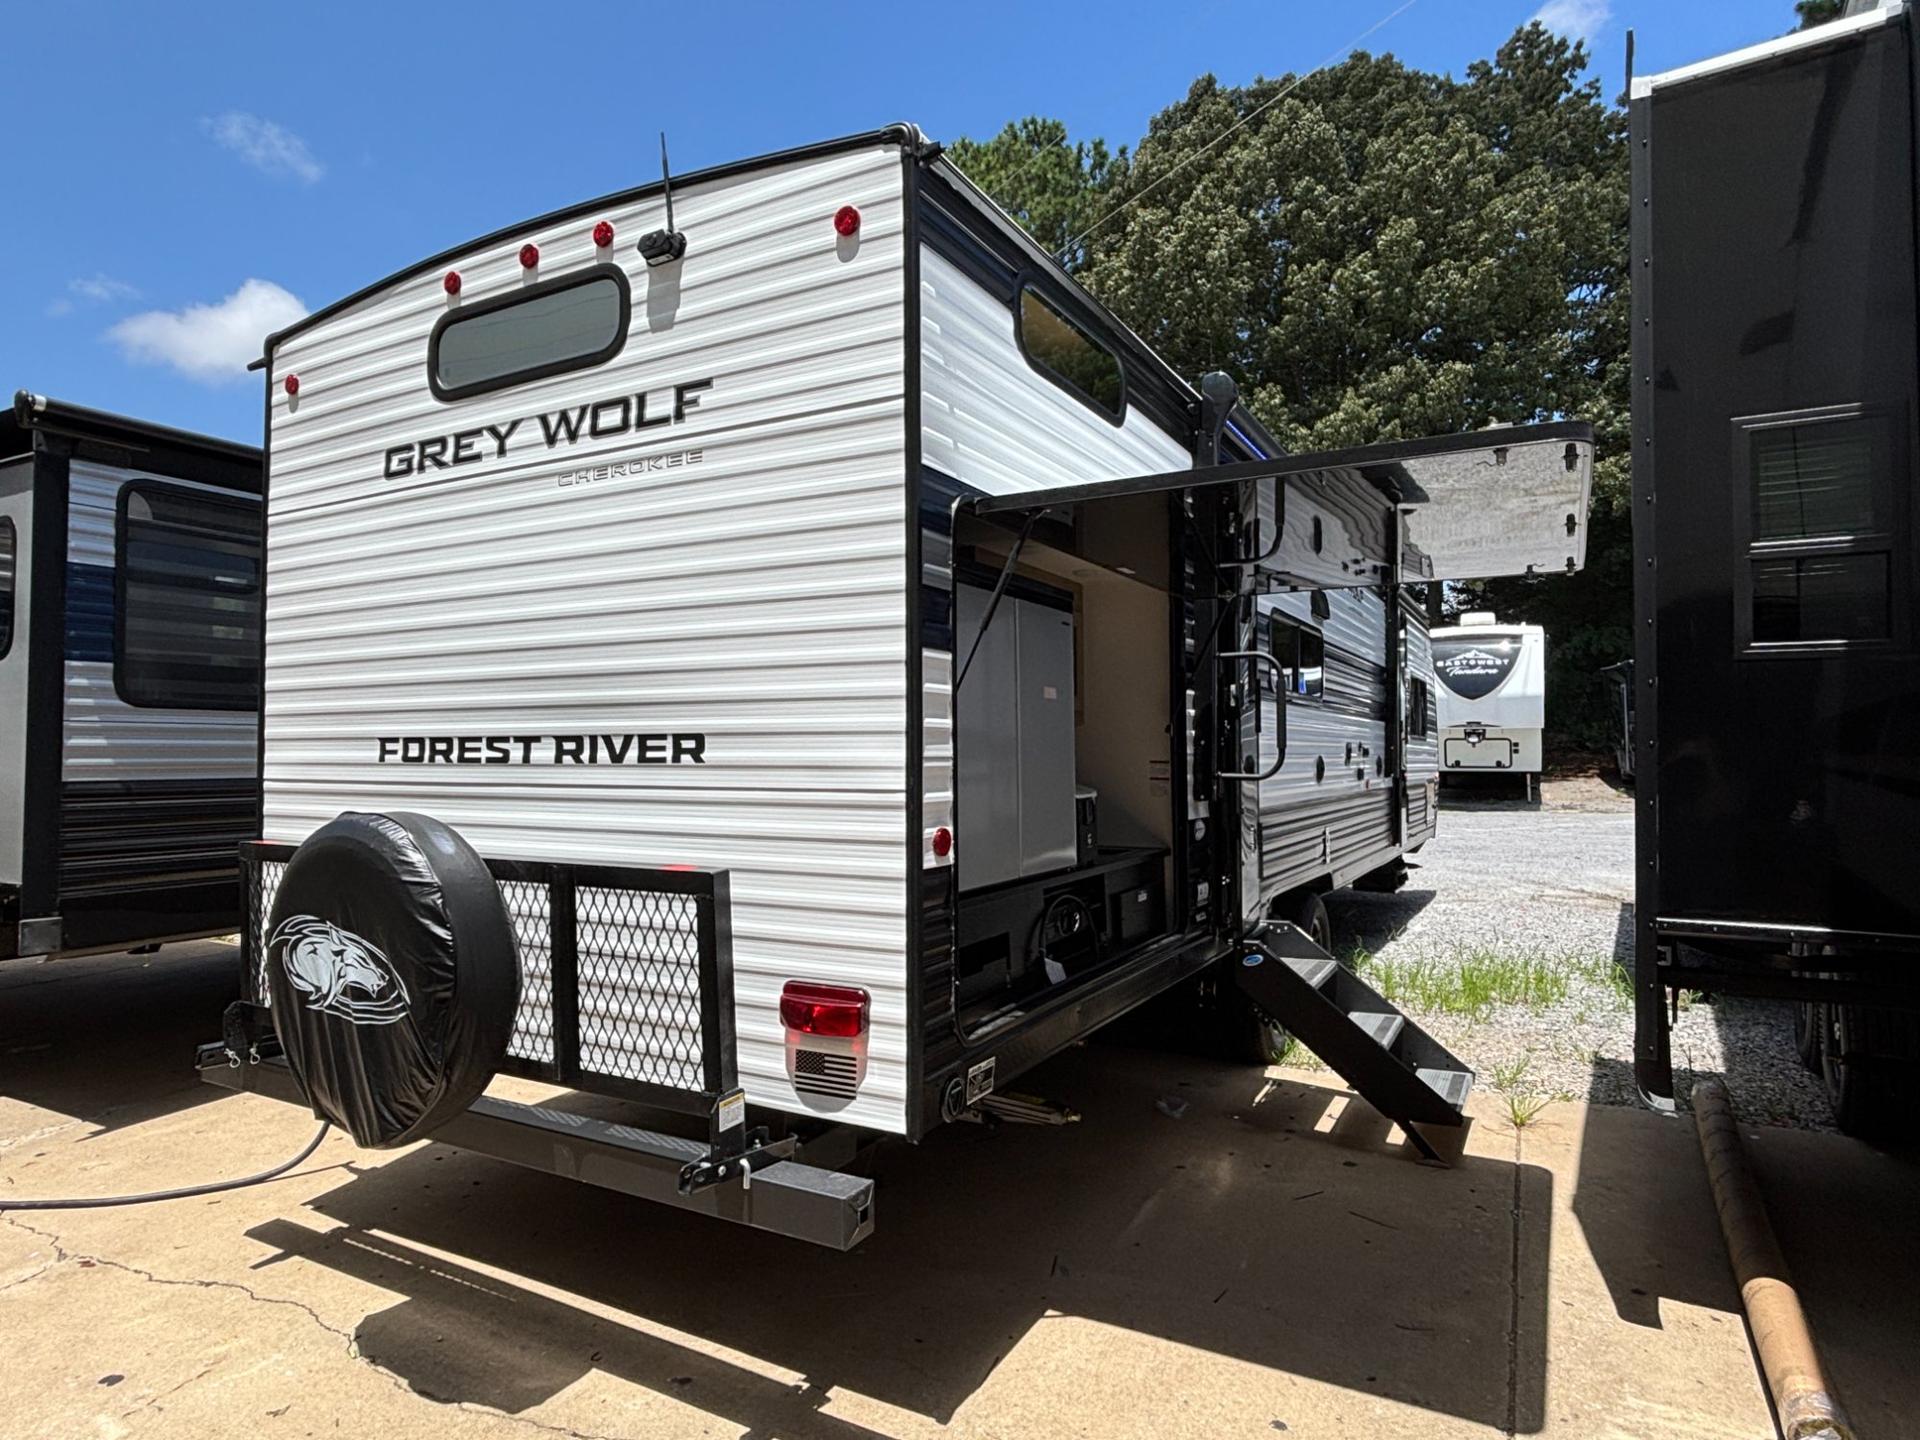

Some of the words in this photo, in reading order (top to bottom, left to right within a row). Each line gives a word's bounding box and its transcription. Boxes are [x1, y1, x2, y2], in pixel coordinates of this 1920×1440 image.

[383, 418, 528, 481] GREY
[536, 377, 714, 450] WOLF
[557, 449, 704, 487] CHEROKEE
[377, 736, 542, 764] FOREST
[551, 732, 706, 764] RIVER
